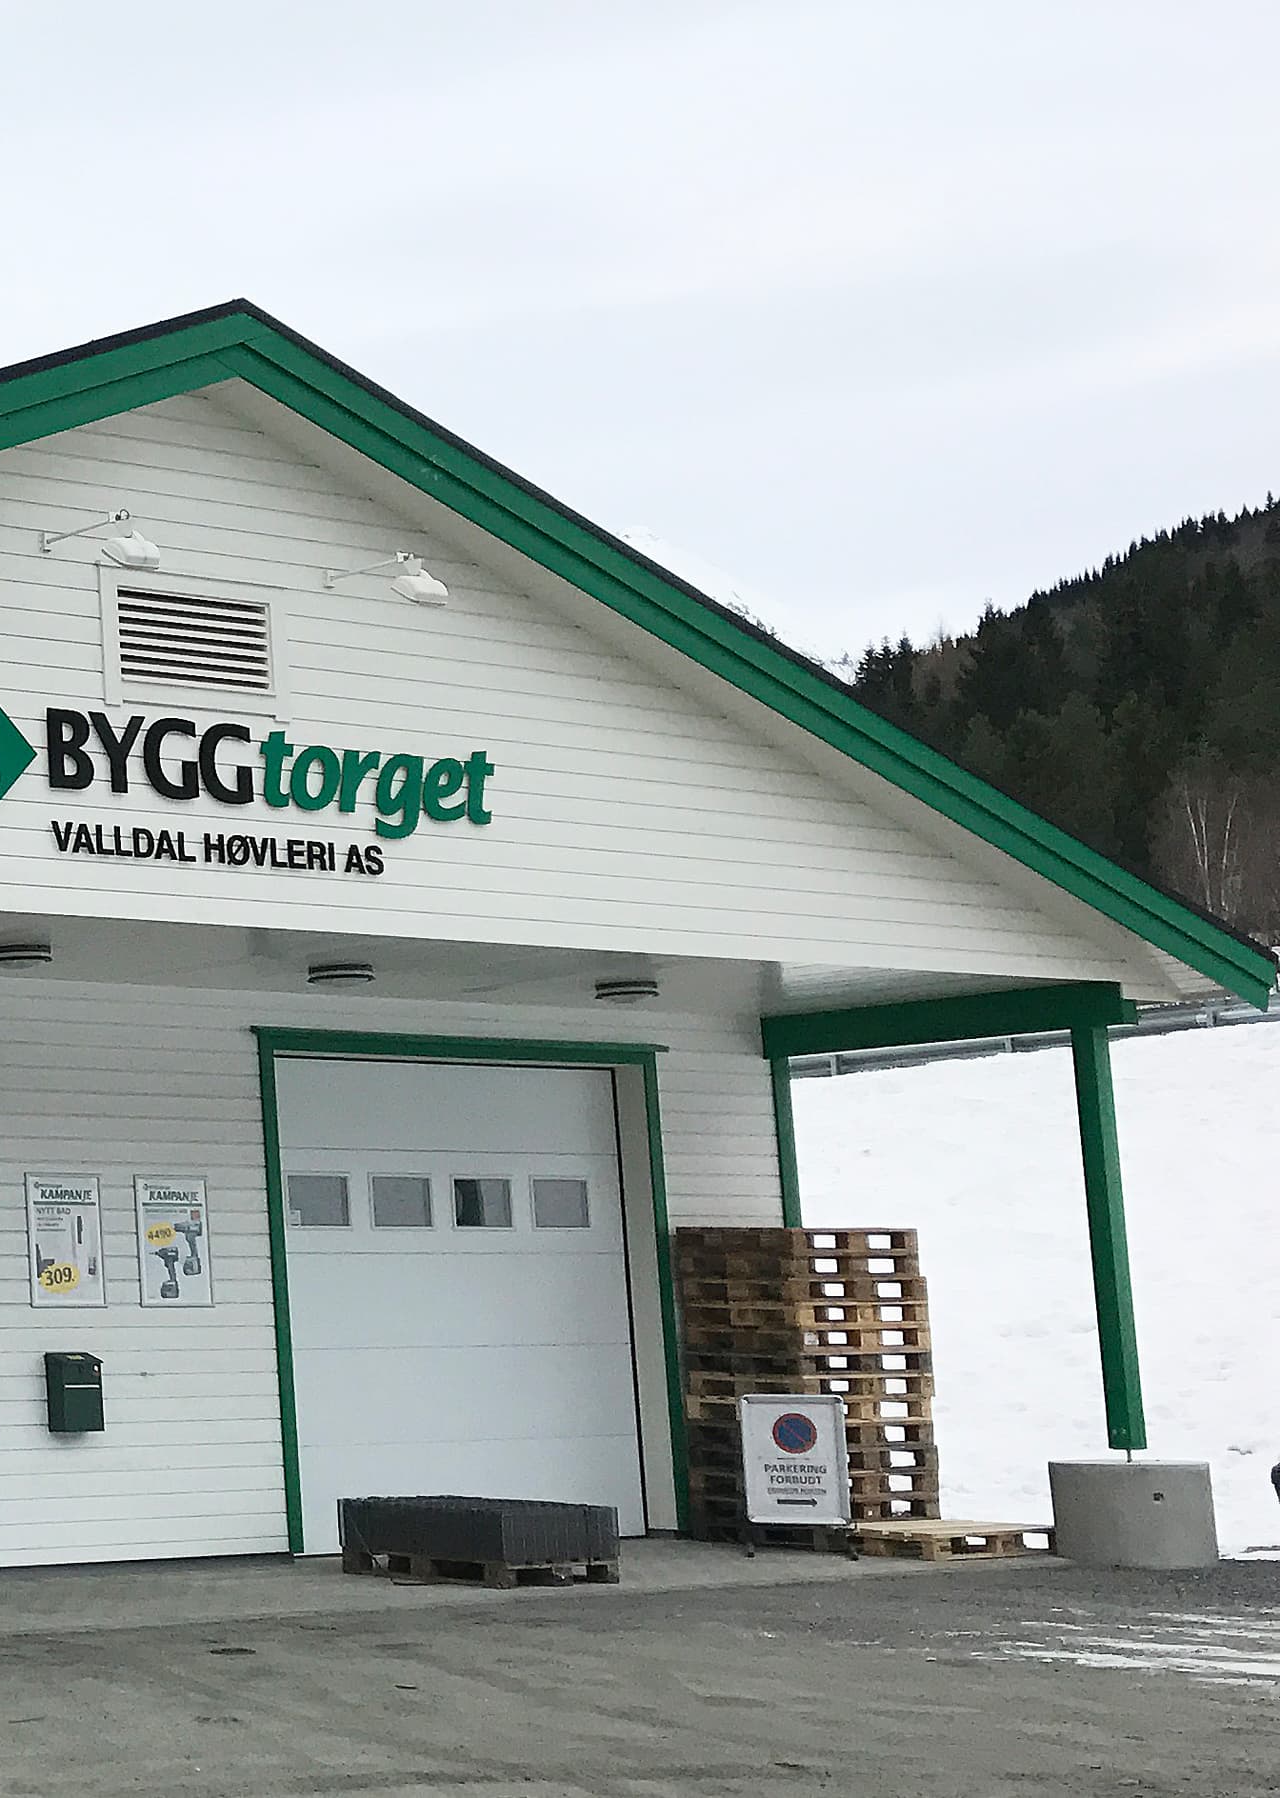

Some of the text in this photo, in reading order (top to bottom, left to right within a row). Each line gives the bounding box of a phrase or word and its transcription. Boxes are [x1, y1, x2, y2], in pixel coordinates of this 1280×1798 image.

[46, 707, 495, 839] BYGGtorget
[51, 820, 385, 876] VALLDAL HØVLERI AS
[40, 1188, 92, 1201] KAMPANJE
[148, 1190, 199, 1202] KAMPANJE
[764, 1464, 827, 1474] PARKERING
[770, 1475, 823, 1485] FORBUDT
